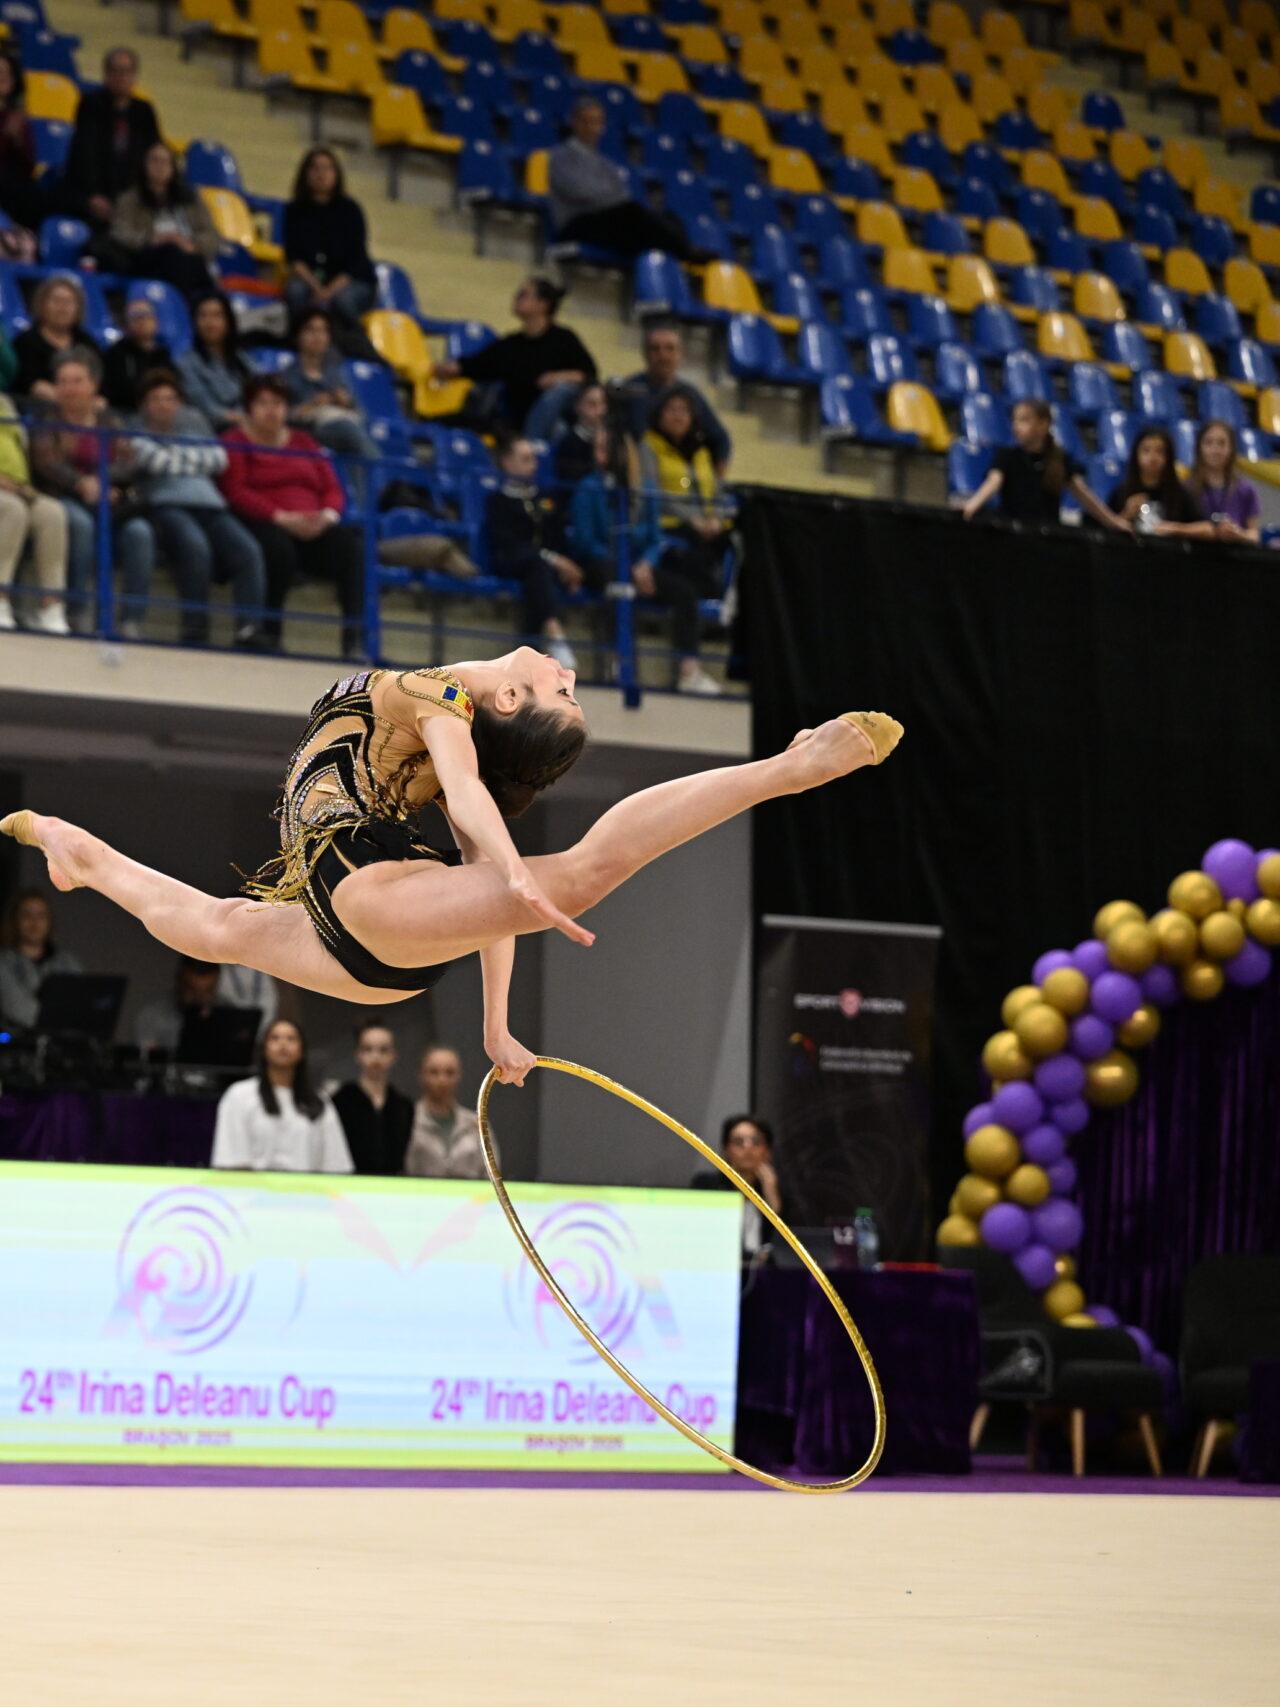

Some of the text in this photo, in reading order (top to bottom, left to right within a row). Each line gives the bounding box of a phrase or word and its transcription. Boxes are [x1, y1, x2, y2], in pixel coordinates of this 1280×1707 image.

[20, 1370, 336, 1431] 24th Irina Deleanu Cup
[485, 1379, 544, 1422] Irina
[668, 1383, 717, 1434] Cup
